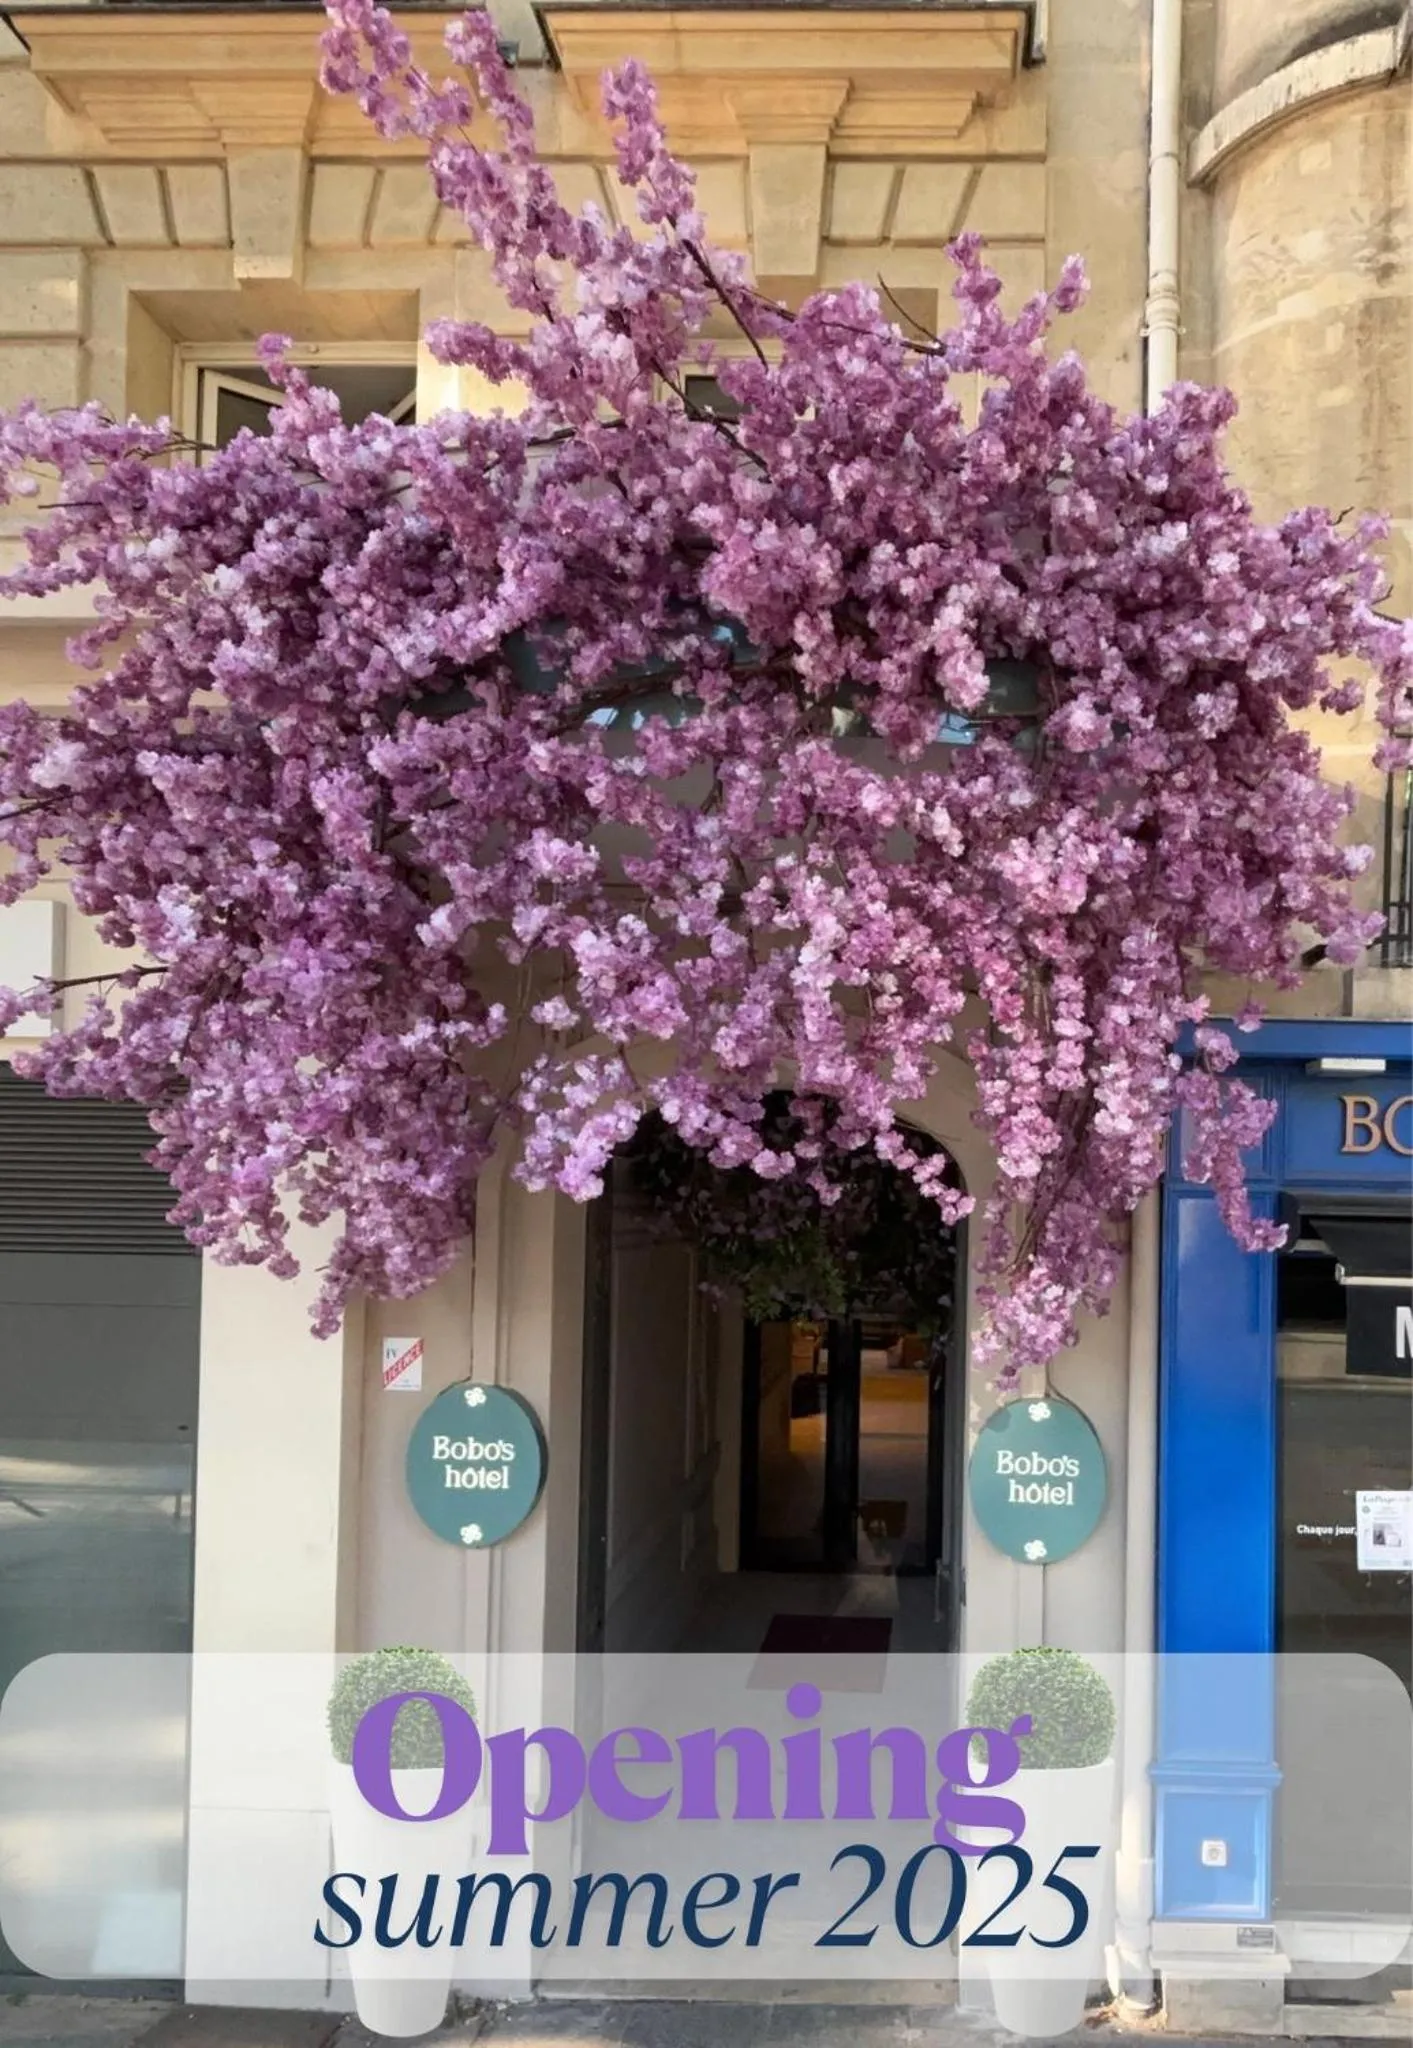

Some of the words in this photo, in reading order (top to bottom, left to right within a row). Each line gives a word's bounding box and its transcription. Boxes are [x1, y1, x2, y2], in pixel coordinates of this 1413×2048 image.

[432, 1435, 516, 1461] Bobo's
[444, 1464, 510, 1489] hôtel
[995, 1450, 1081, 1477] Bobo's
[1008, 1479, 1074, 1505] hôtel
[1296, 1524, 1333, 1536] Chaque
